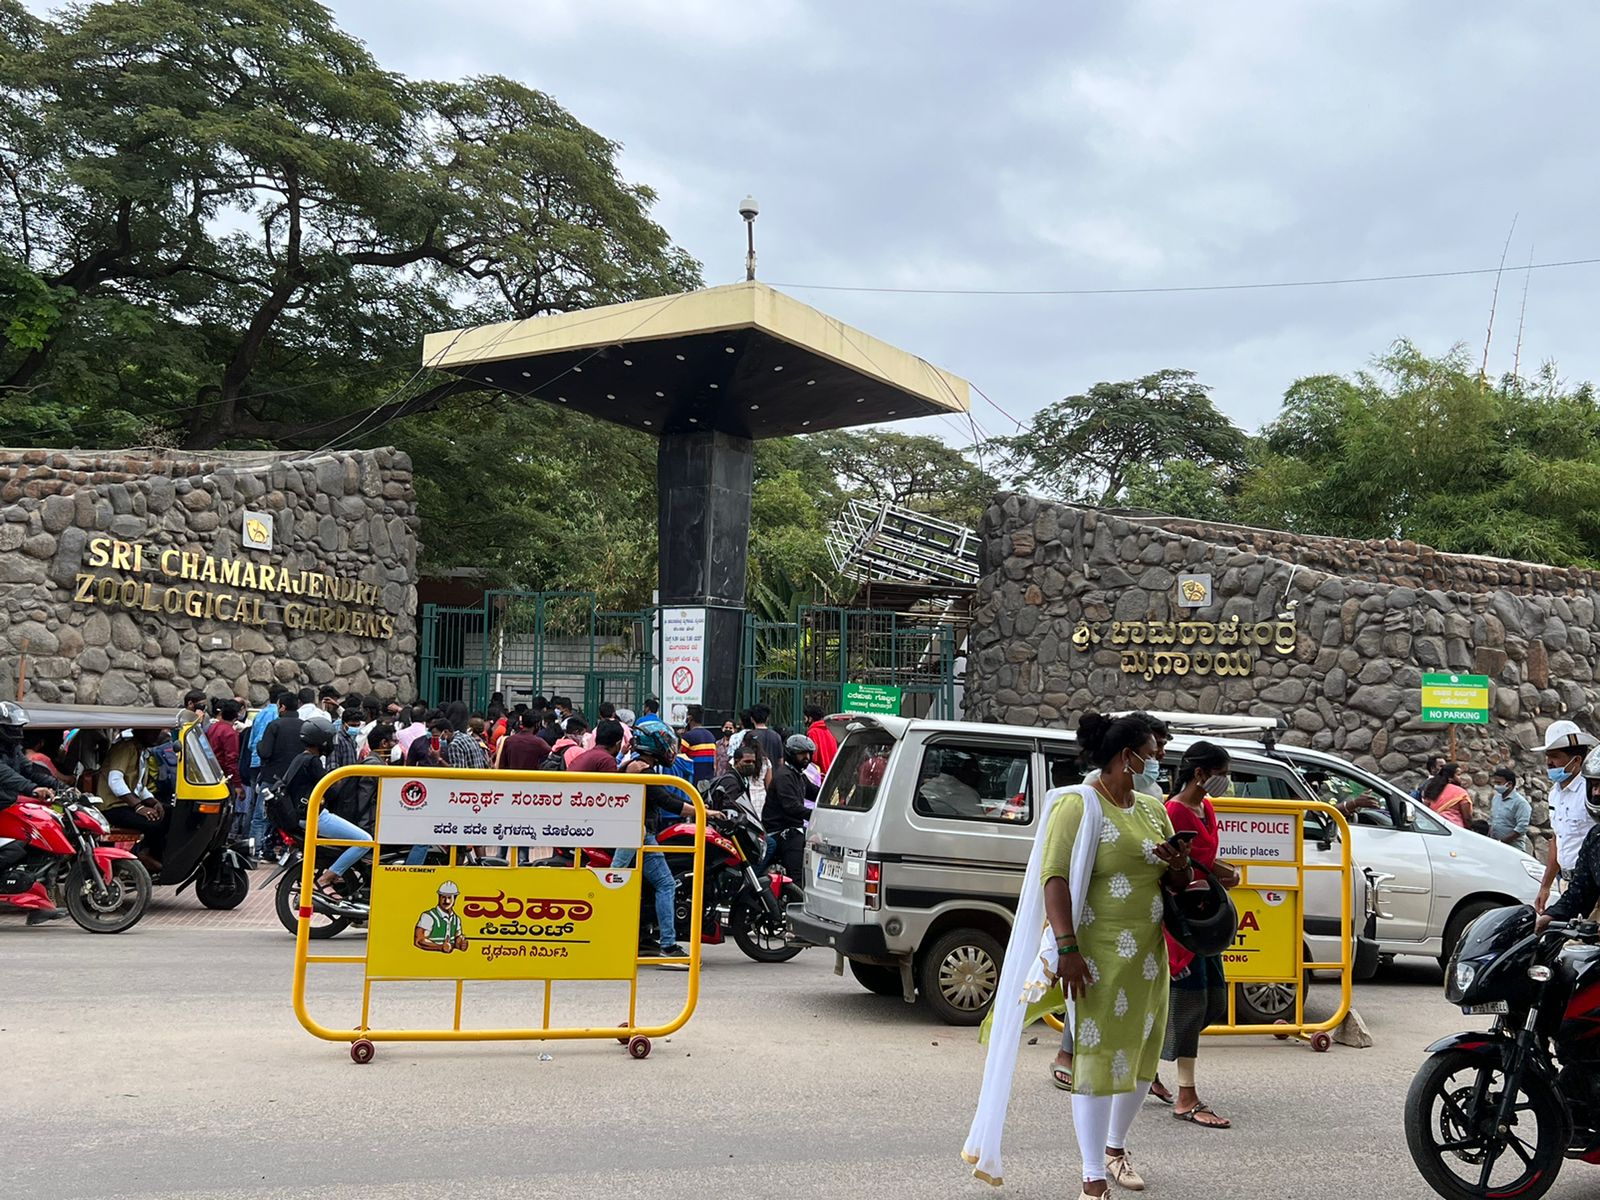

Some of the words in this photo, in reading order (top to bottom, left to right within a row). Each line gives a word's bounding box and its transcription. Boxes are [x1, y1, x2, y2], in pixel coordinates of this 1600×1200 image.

[89, 538, 143, 572] SRI
[160, 549, 381, 606] CHAMARAJENDRA
[74, 572, 268, 625] ZOOLOGICAL
[284, 603, 395, 639] GARDENS
[1072, 618, 1101, 652] ಶ್ರೀ
[1111, 615, 1297, 654] ಚಾಮರಾಜೇಂದ್ರ
[1120, 650, 1253, 681] ಮೃಗಾಲಯ
[1429, 711, 1442, 719] NO
[1443, 711, 1480, 720] PARKING
[448, 790, 504, 813] ಸಿದ್ಧಾರ್ಥ
[511, 791, 562, 807] ಸಂಚಾರ
[570, 791, 630, 808] ಪೊಲೀಸ್
[433, 823, 458, 835] ಪದೇ
[463, 823, 487, 835] ಪದೇ
[493, 824, 536, 840] ಕೈಗಳನ್ನು
[542, 825, 594, 837] ತೊಳೆಯಿರಿ
[1216, 820, 1247, 832] AFFIC
[1251, 821, 1289, 834] POLICE
[1220, 845, 1247, 856] public
[1250, 846, 1279, 857] places
[463, 889, 593, 921] ಮಹಾ
[479, 921, 574, 937] ಸಿಮೆಂಟ್
[481, 944, 526, 961] ದೃಢವಾಗಿ
